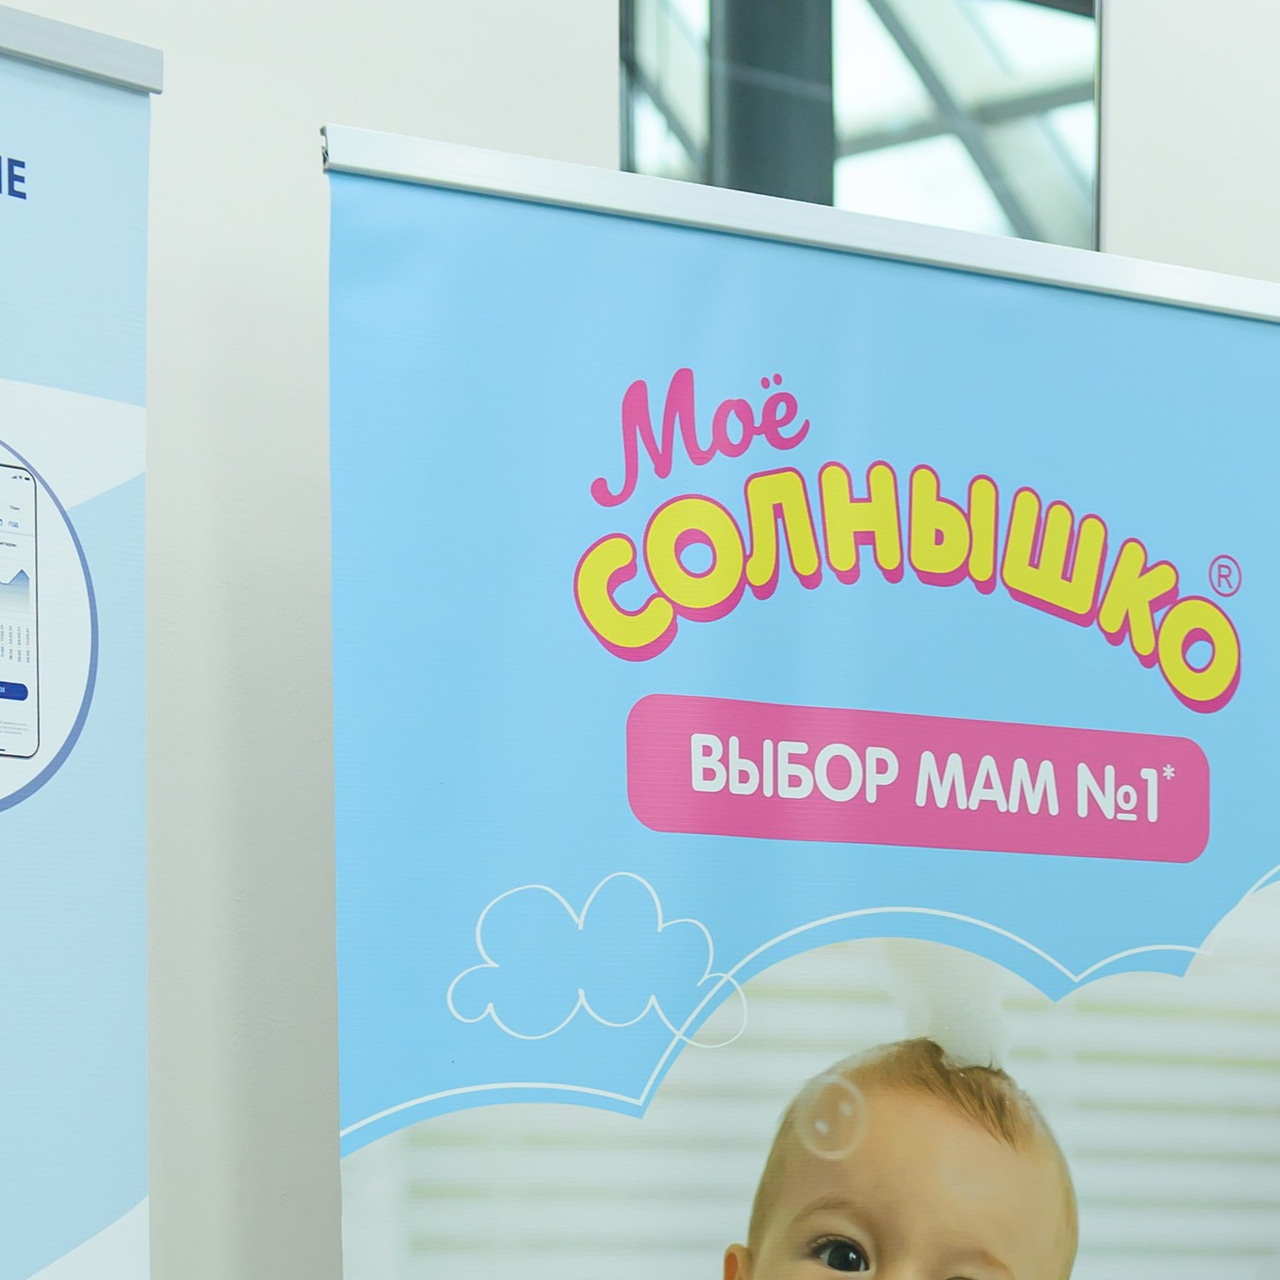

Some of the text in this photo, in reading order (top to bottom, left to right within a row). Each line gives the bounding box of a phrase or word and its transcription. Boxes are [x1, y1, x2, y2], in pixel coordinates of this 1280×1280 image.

[591, 368, 810, 507] Моё
[690, 733, 899, 804] ВЫБОР
[916, 750, 1060, 816] МАМ
